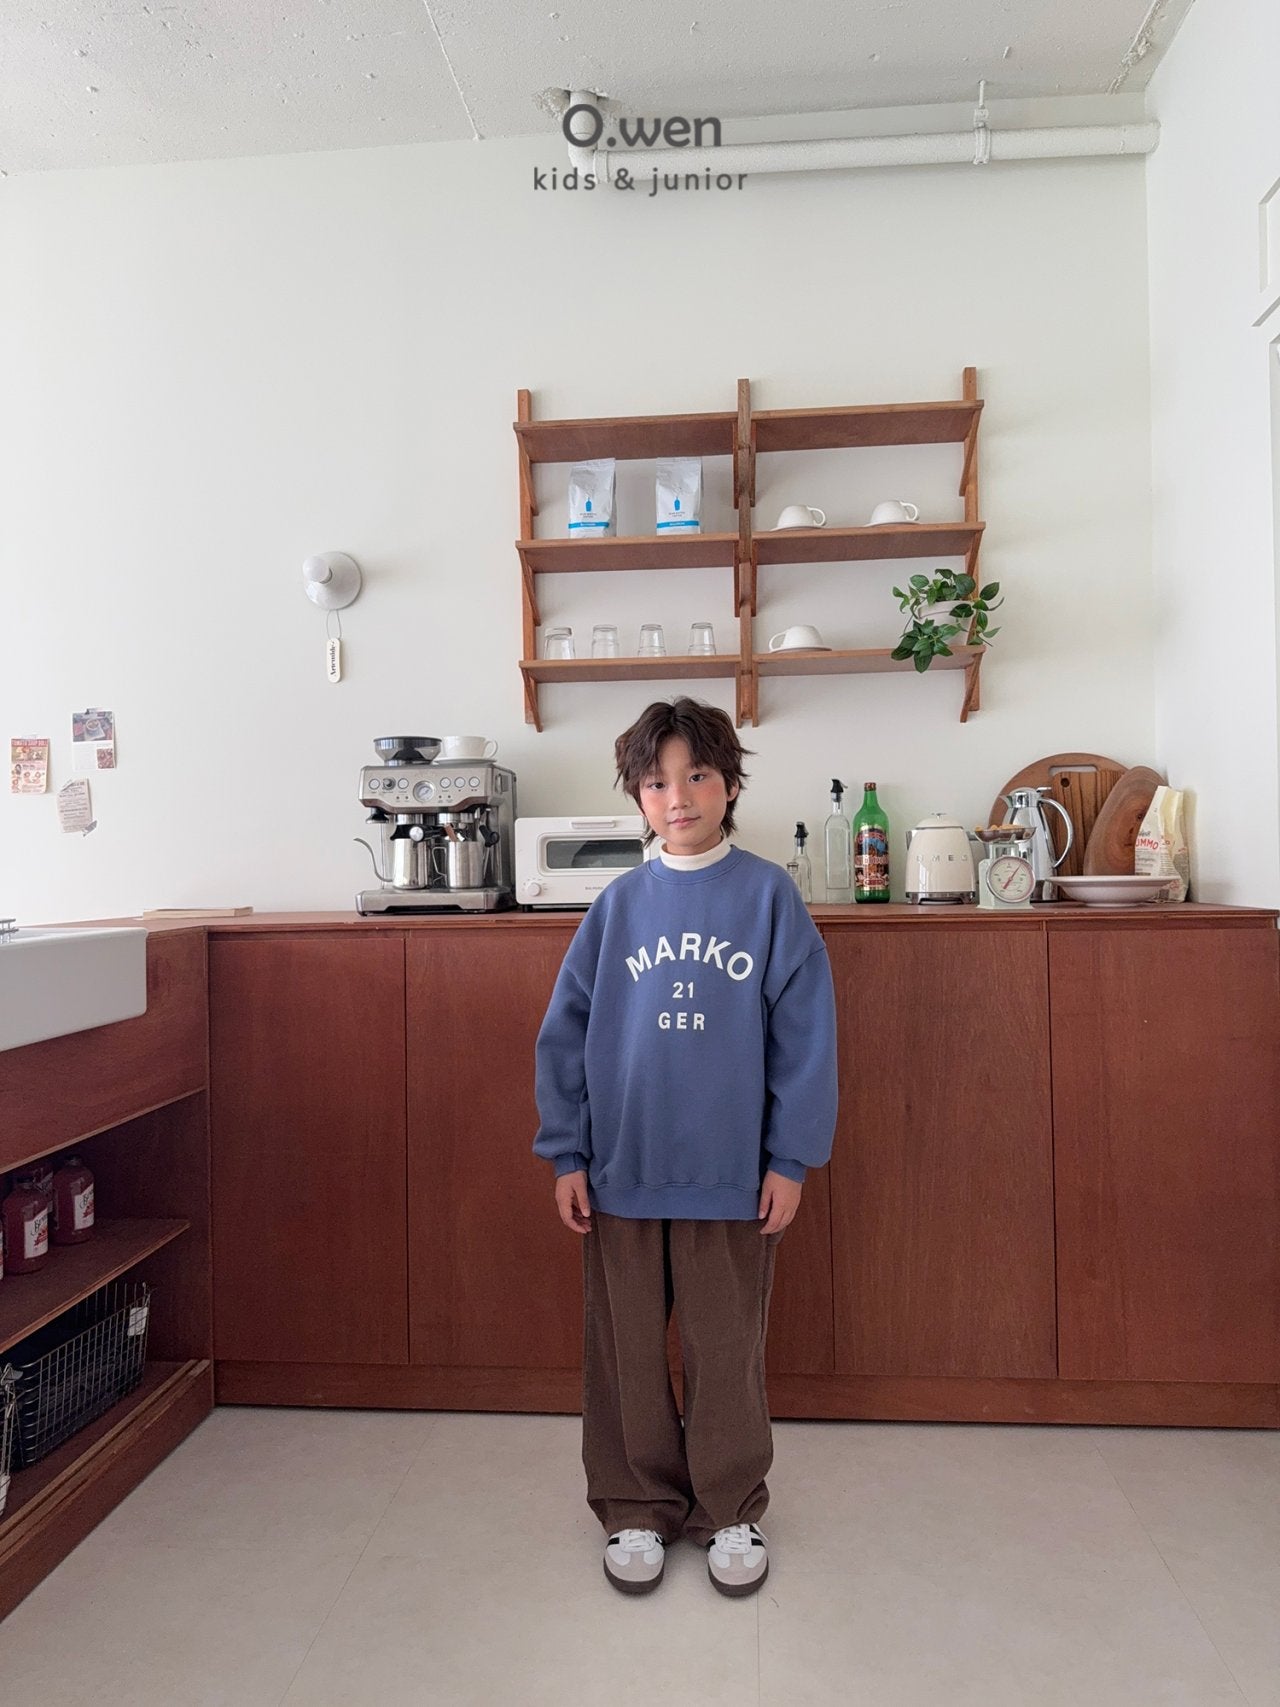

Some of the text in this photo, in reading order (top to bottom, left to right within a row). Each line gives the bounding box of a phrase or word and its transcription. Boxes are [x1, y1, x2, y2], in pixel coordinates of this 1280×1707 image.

[625, 932, 754, 982] MARKO
[672, 981, 694, 998] 21
[658, 1012, 705, 1030] GER
